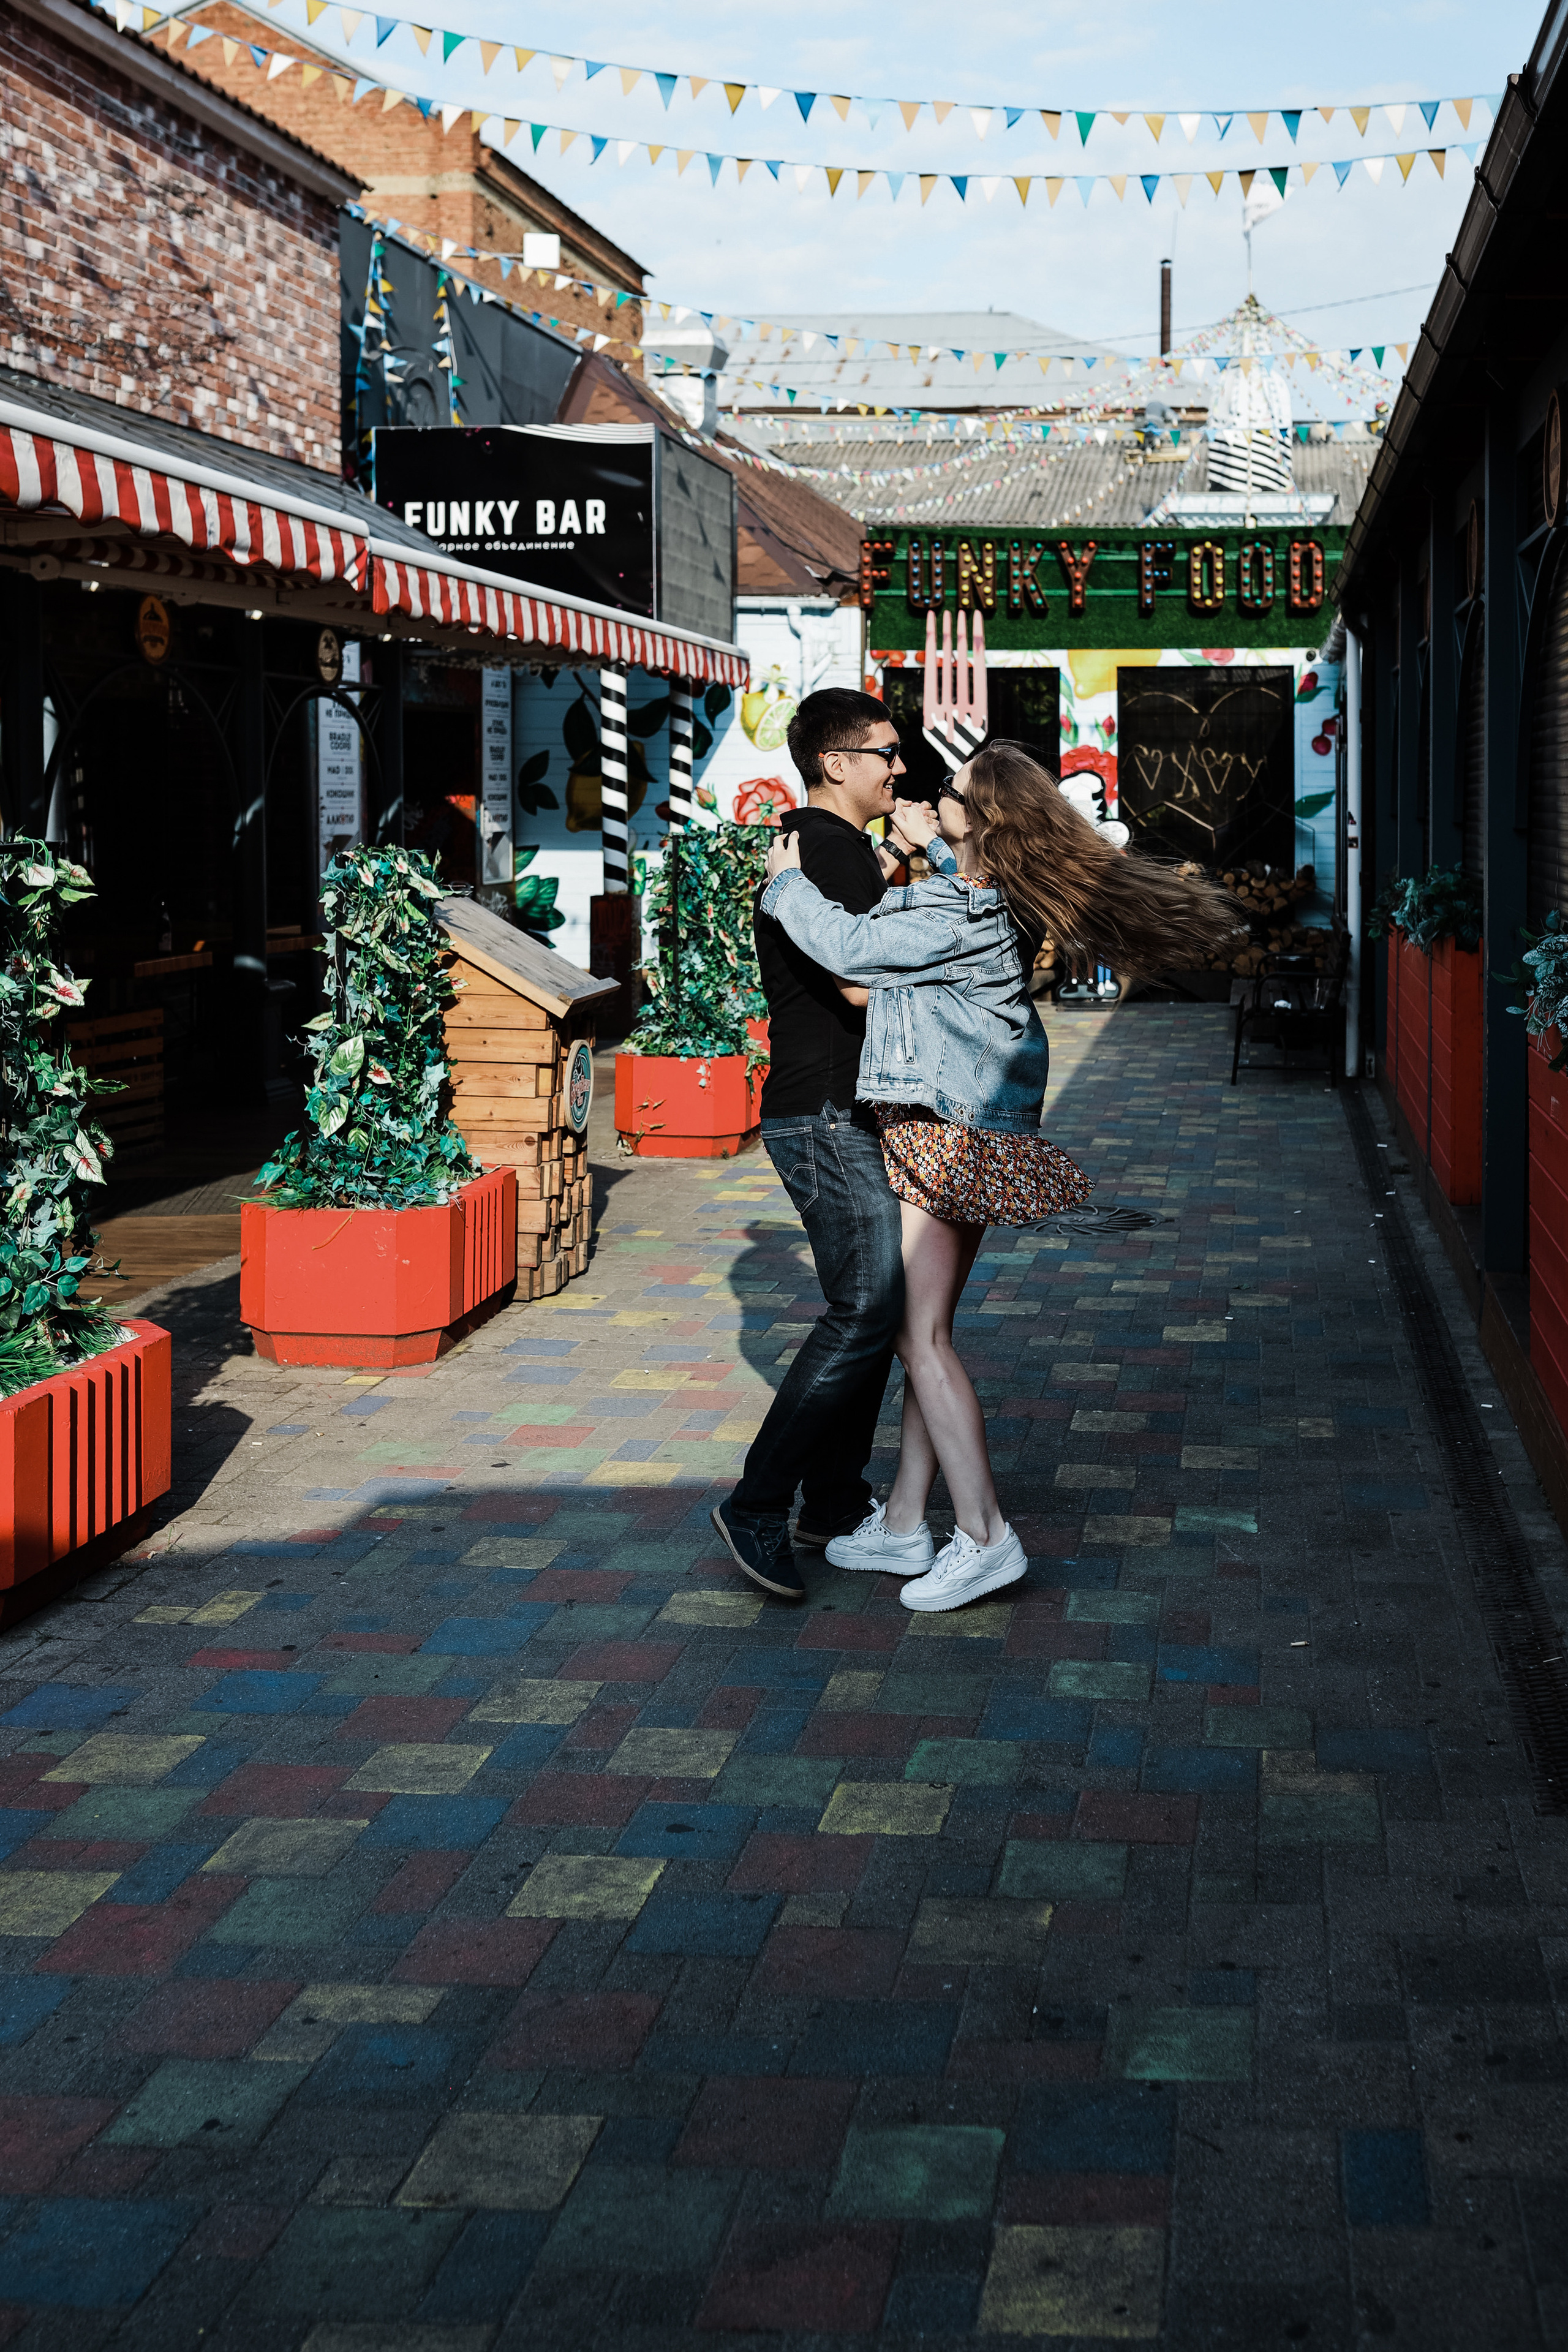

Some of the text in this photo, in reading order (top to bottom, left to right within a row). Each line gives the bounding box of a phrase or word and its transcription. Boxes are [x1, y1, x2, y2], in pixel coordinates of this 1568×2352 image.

[404, 499, 606, 536] FUNKY BAR
[434, 540, 575, 552] арное объединение
[859, 539, 1325, 608] FUNKY FOOD
